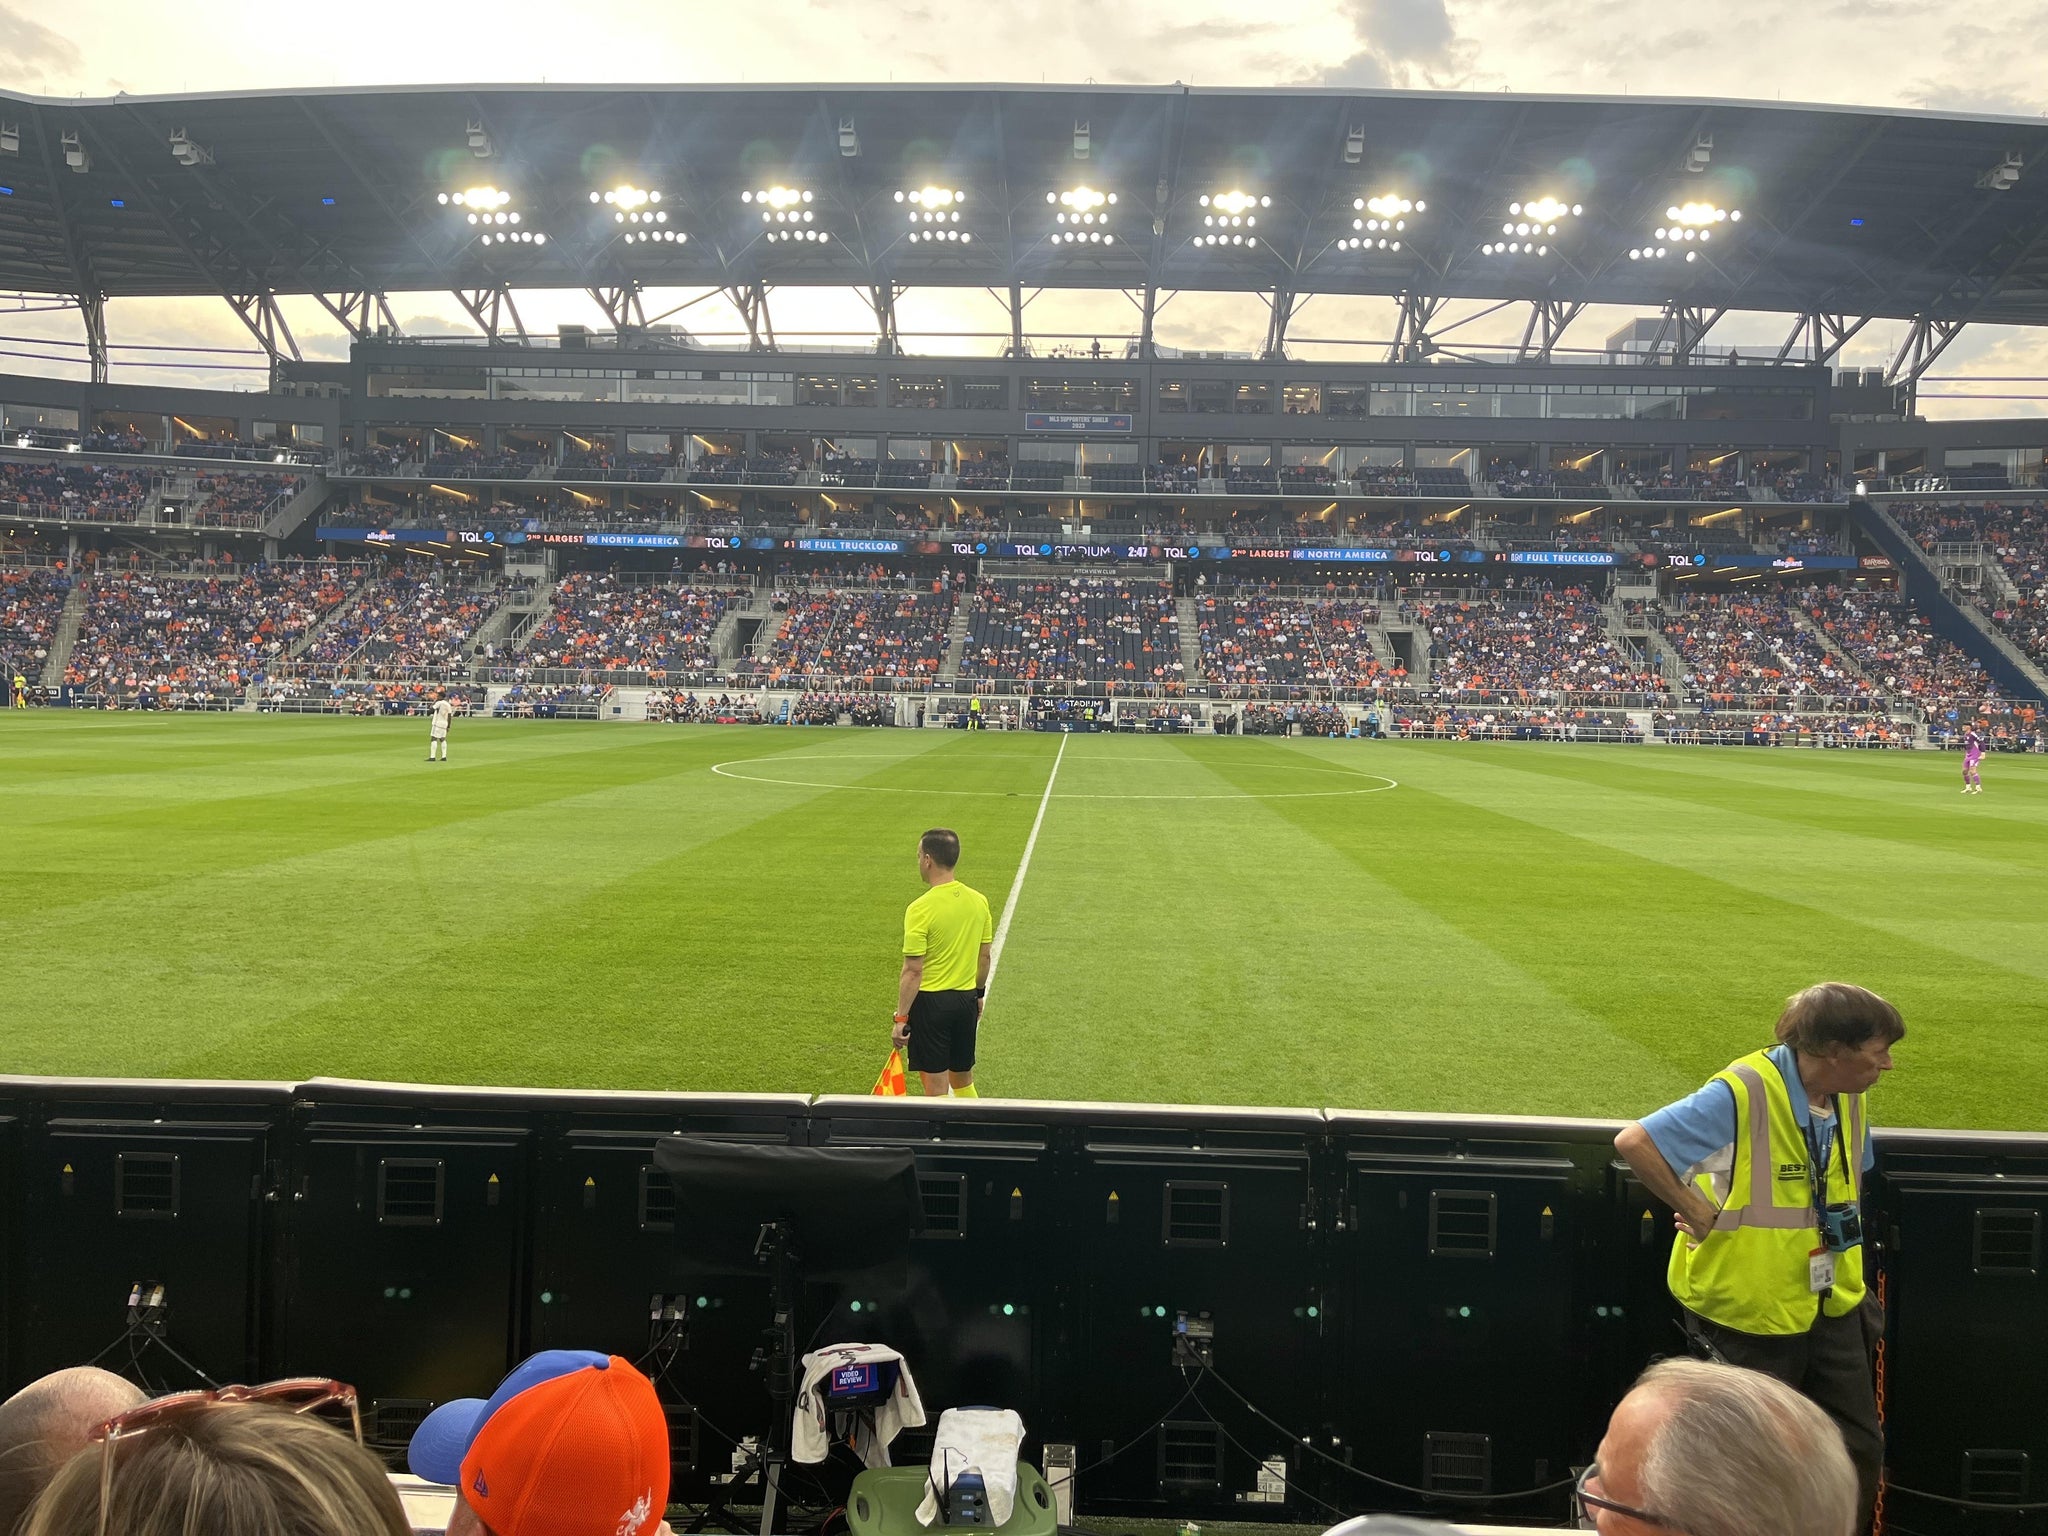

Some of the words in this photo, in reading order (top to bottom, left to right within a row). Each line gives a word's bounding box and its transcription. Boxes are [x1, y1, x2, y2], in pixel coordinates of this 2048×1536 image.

[459, 532, 482, 542] TQL
[544, 534, 584, 542] LARGEST
[602, 536, 634, 544] NORTH
[638, 537, 679, 545] AMERICA
[705, 537, 728, 548] TQL
[784, 540, 795, 548] #1
[815, 541, 837, 549] FULL
[840, 541, 898, 550] TRUCKLOAD
[952, 543, 974, 554] TQL
[1015, 544, 1039, 556] TQL
[1128, 546, 1148, 558] 2:47
[1164, 547, 1187, 558] TQL
[1344, 551, 1388, 559] AMERICA
[1414, 551, 1438, 562] TQL
[1494, 553, 1506, 561] #1
[1526, 554, 1549, 562] FULL
[1552, 554, 1613, 563] TRUCKLOAD
[1668, 556, 1692, 566] TQL
[840, 1376, 862, 1384] REVIEW
